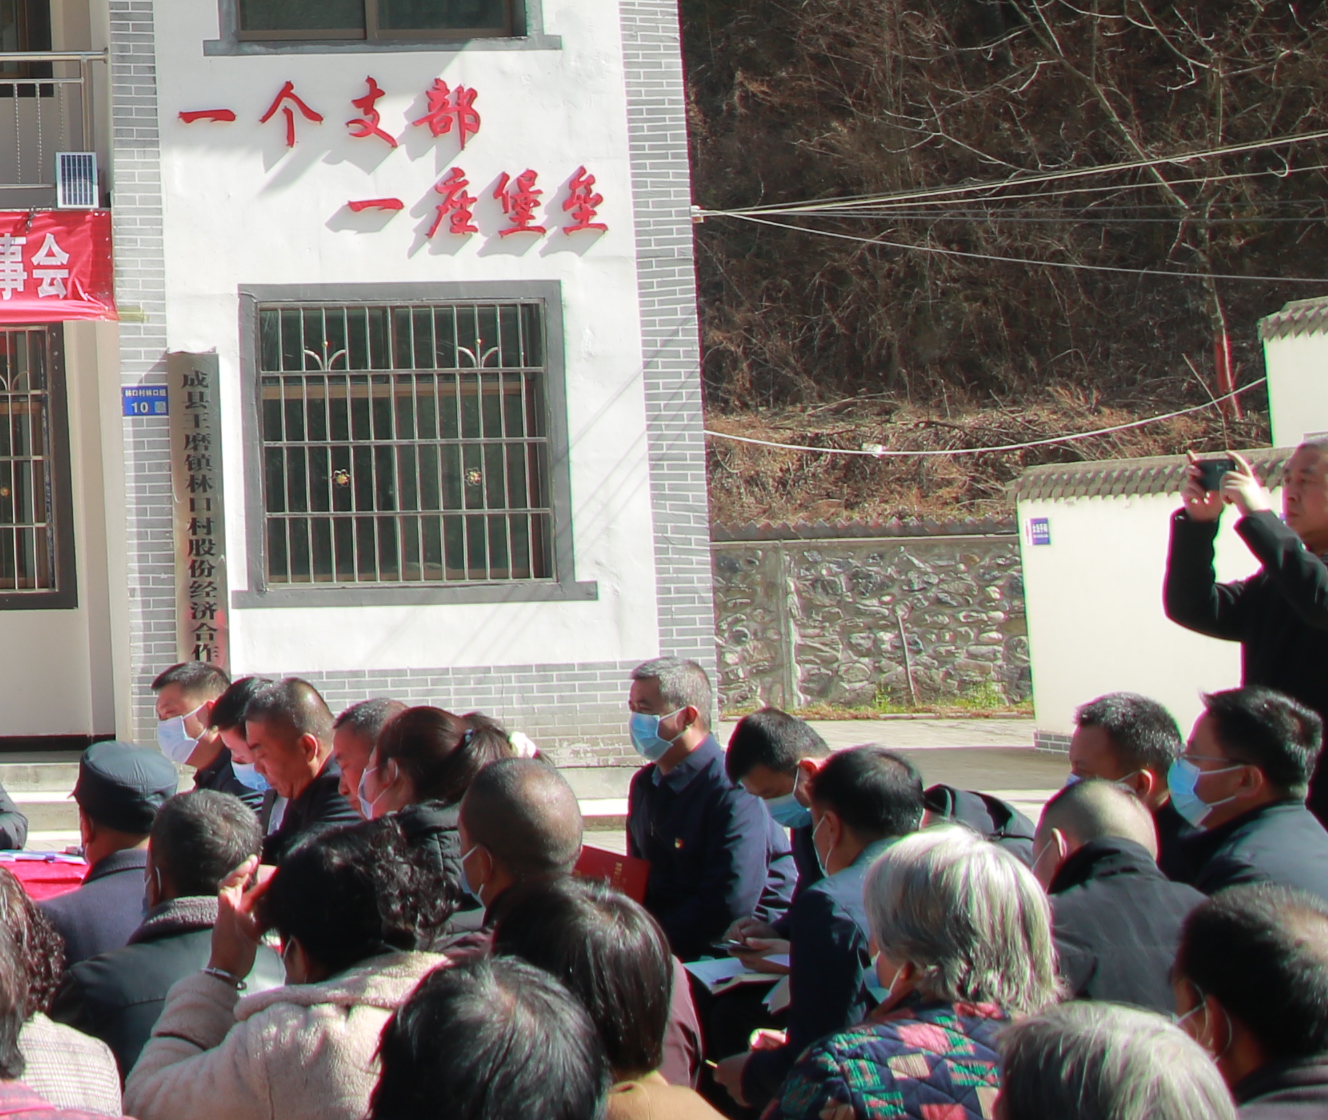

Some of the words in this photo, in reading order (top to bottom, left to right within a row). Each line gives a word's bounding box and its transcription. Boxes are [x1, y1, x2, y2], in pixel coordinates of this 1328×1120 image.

[177, 75, 482, 151] 一个支部
[347, 165, 609, 240] 一座堡垒
[131, 401, 149, 414] 10
